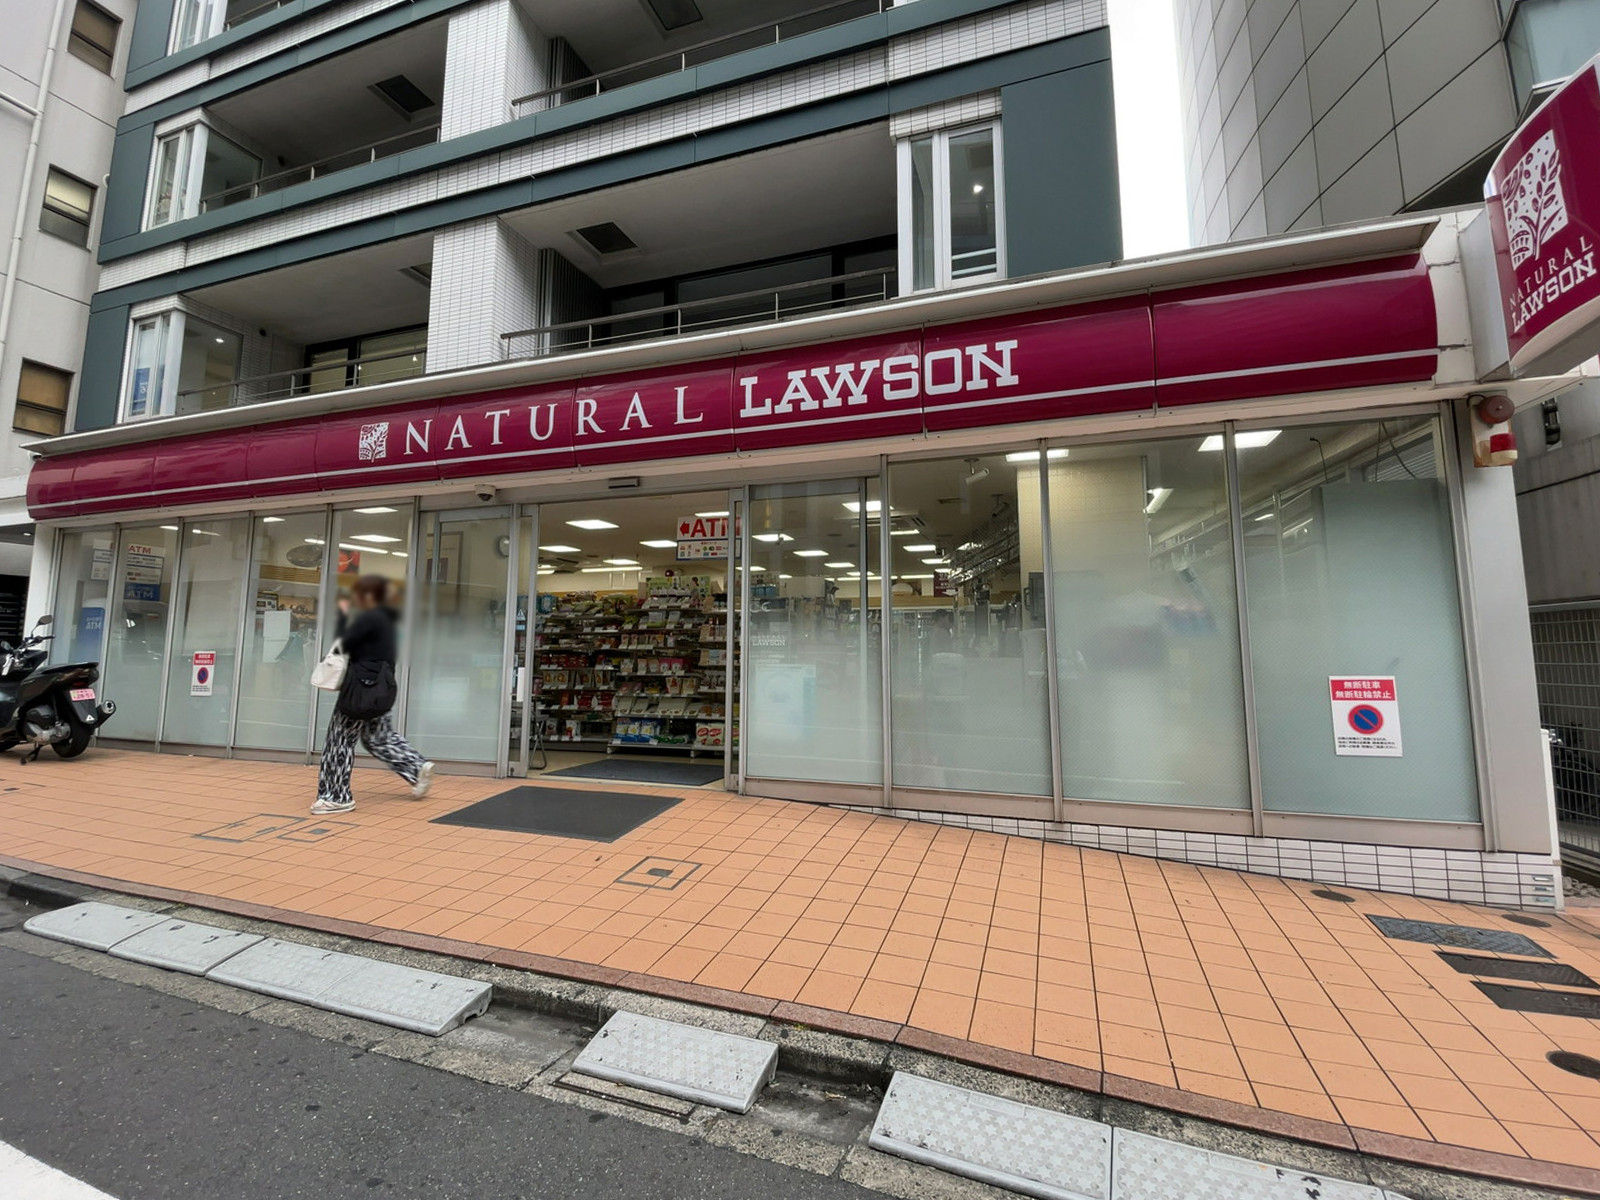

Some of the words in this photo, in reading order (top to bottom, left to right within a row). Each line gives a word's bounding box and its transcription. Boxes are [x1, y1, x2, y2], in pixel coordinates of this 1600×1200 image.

[1510, 236, 1593, 311] NATURAL
[1512, 251, 1597, 333] LAWSON
[404, 386, 704, 455] NATURAL
[740, 339, 1019, 418] LAWSON
[128, 545, 152, 554] ATM
[127, 589, 153, 599] ATM
[85, 621, 102, 630] ATM
